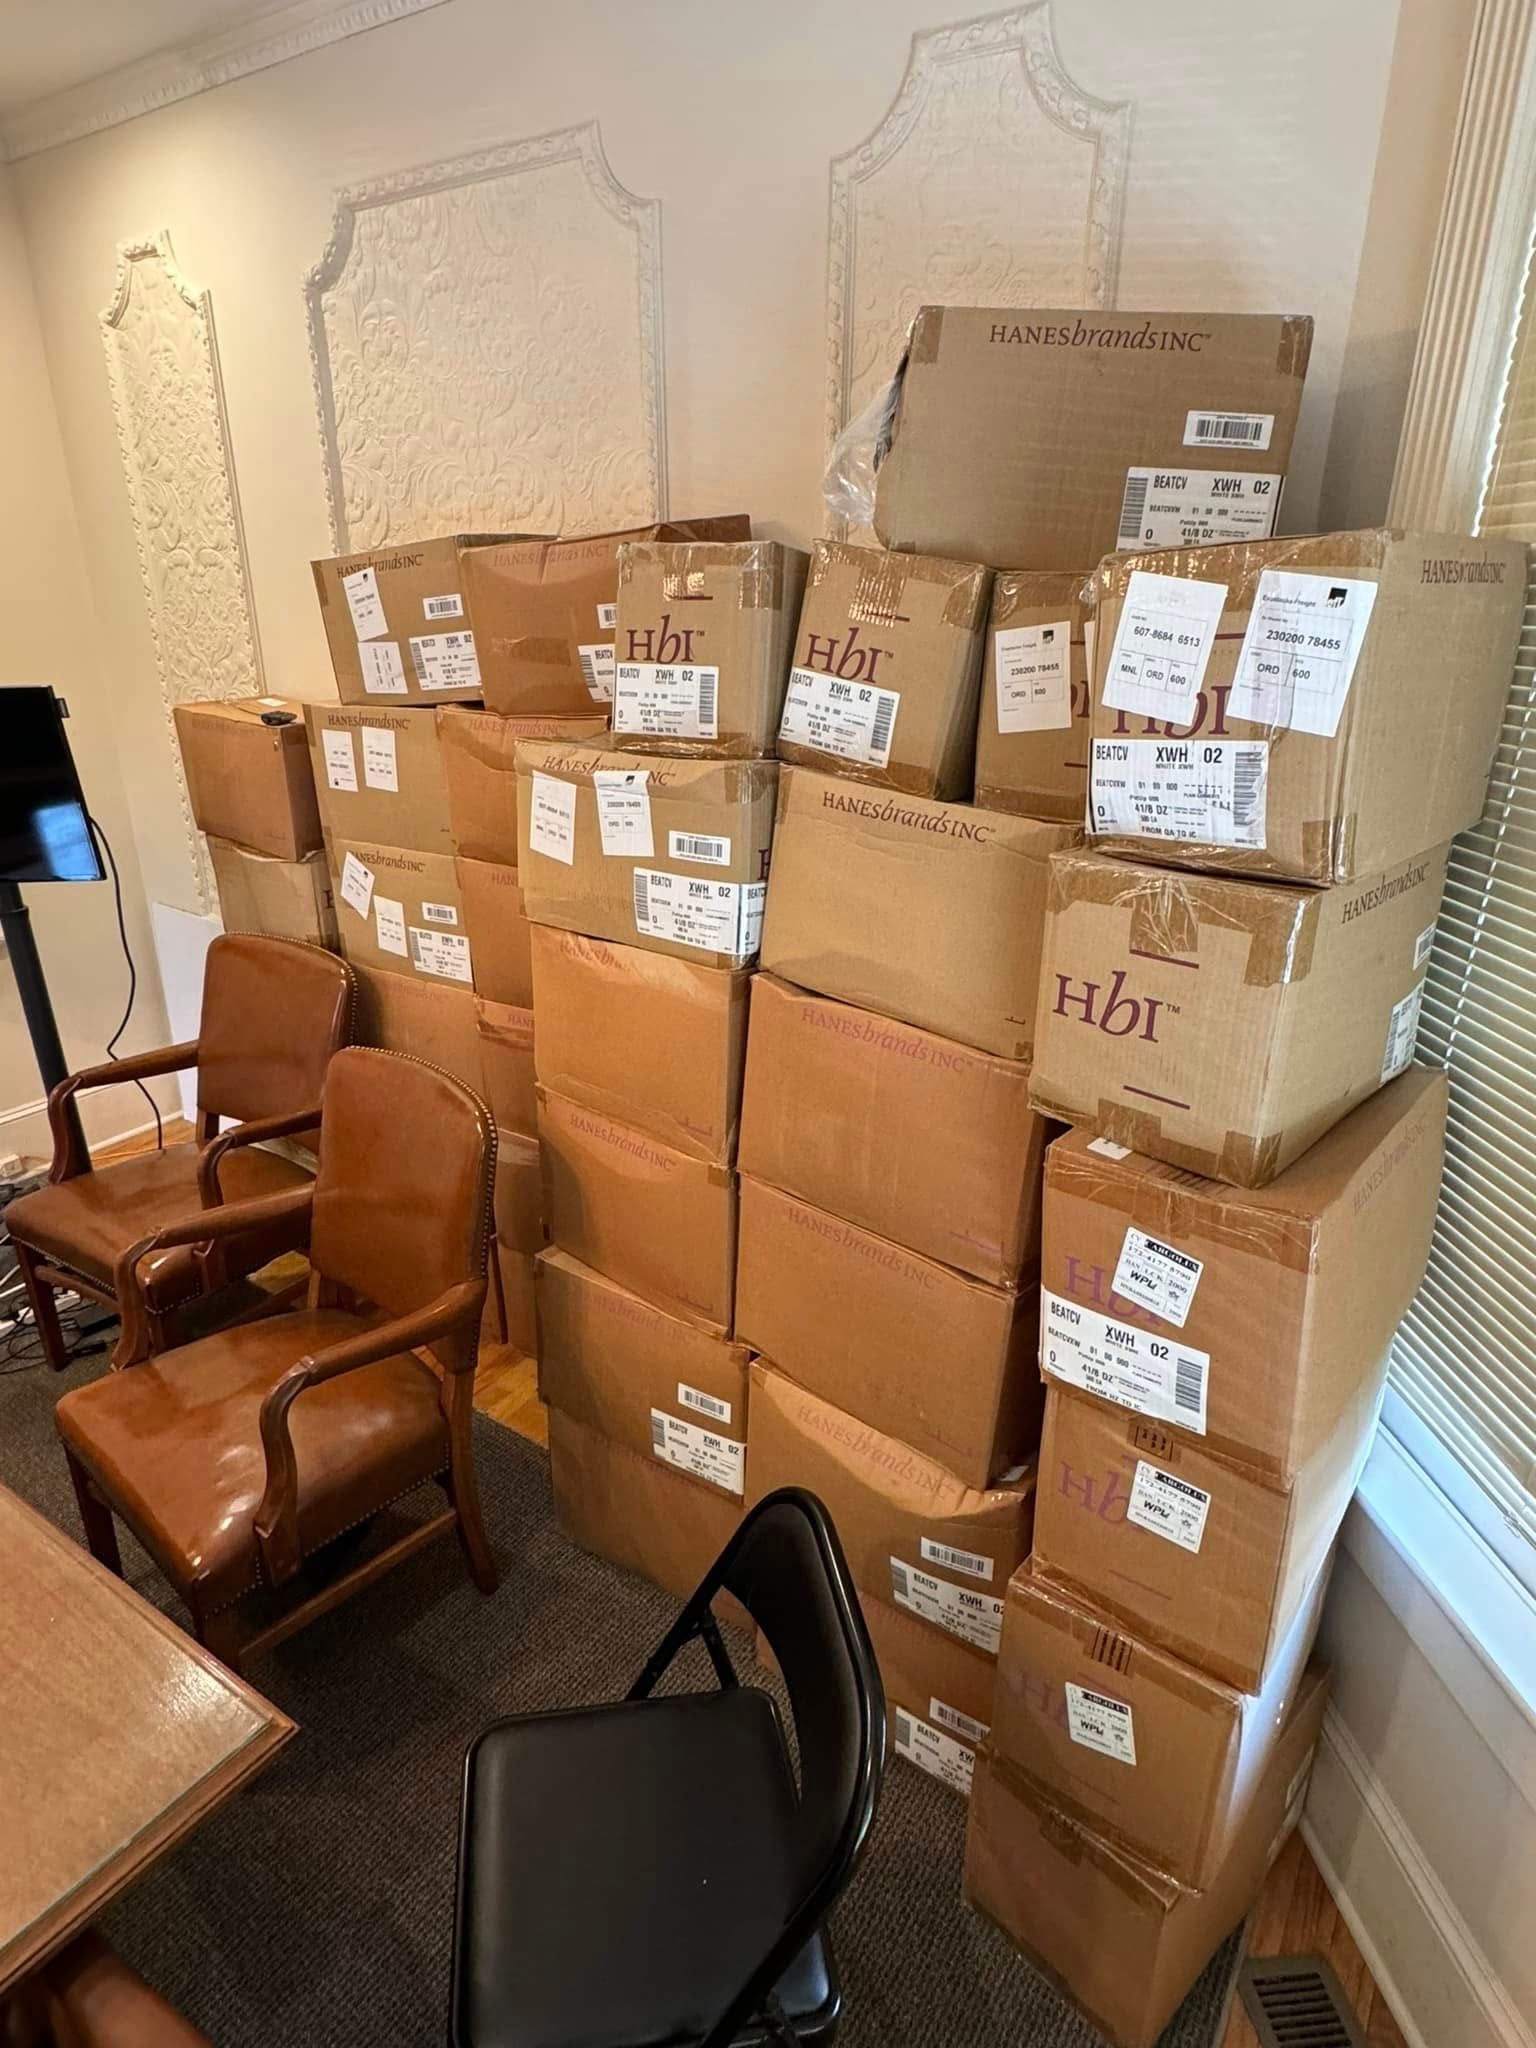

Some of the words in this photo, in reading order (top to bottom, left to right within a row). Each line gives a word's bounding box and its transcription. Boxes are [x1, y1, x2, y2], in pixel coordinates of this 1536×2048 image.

[1153, 475, 1188, 490] BEATCV
[1212, 478, 1242, 493] XWH
[1253, 480, 1271, 494] 02
[1178, 634, 1201, 648] 6513
[1266, 629, 1305, 645] 230200
[1307, 636, 1341, 650] 78455
[655, 669, 675, 681] XWH
[682, 670, 694, 681] 02
[1121, 664, 1138, 675] MNL
[1146, 669, 1164, 680] ORD
[1257, 663, 1280, 675] ORD
[1292, 668, 1311, 680] 600
[1170, 674, 1186, 685] 600
[829, 681, 851, 697] XWH
[859, 688, 872, 703] 02
[1096, 745, 1129, 761] BEATCV
[1155, 746, 1188, 763] XWH
[1203, 747, 1222, 764] 02
[1156, 805, 1168, 815] DZ
[688, 881, 709, 895] XWH
[718, 886, 731, 898] 02
[1051, 1301, 1081, 1326] BEATCV
[1105, 1325, 1135, 1347] XWH
[1150, 1342, 1169, 1361] 02
[728, 1444, 740, 1456] 02
